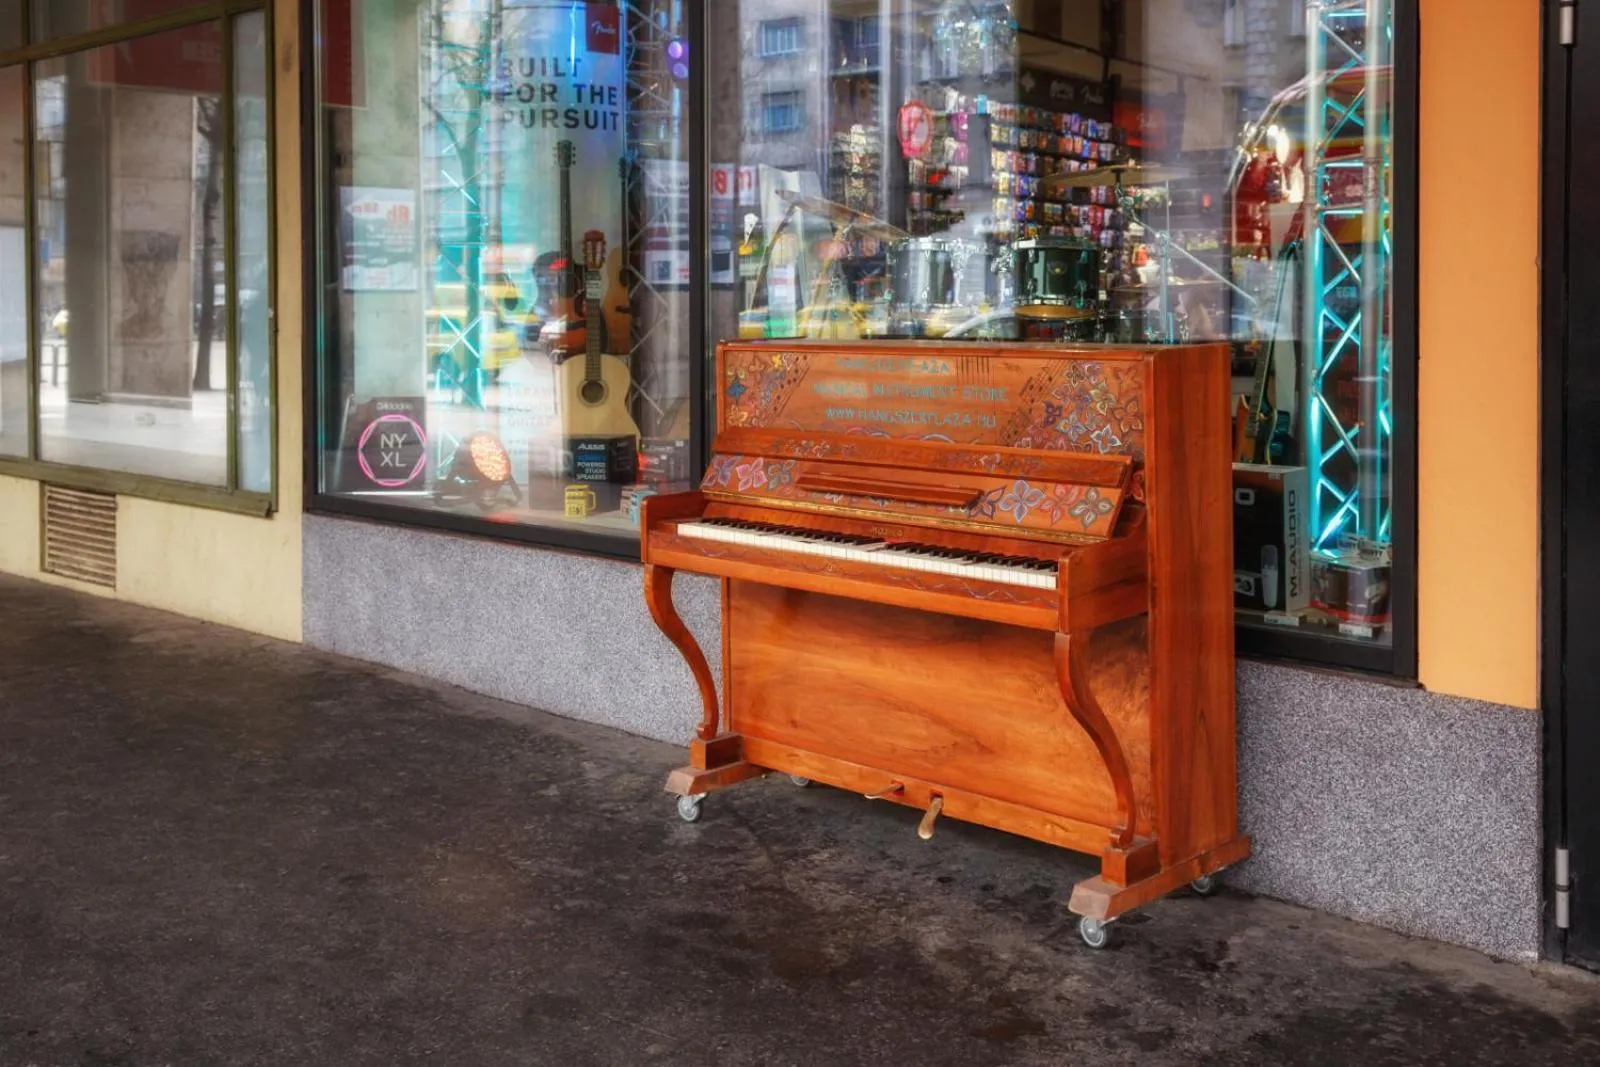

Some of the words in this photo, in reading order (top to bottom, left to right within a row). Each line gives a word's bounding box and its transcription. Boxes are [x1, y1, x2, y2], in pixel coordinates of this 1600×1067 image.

[497, 57, 583, 78] BUILT
[497, 83, 559, 104] FOR
[572, 84, 618, 106] THE
[500, 109, 620, 131] PURSUIT
[380, 433, 408, 449] NY
[379, 451, 408, 467] XL
[1288, 489, 1298, 598] M-AUDIO
